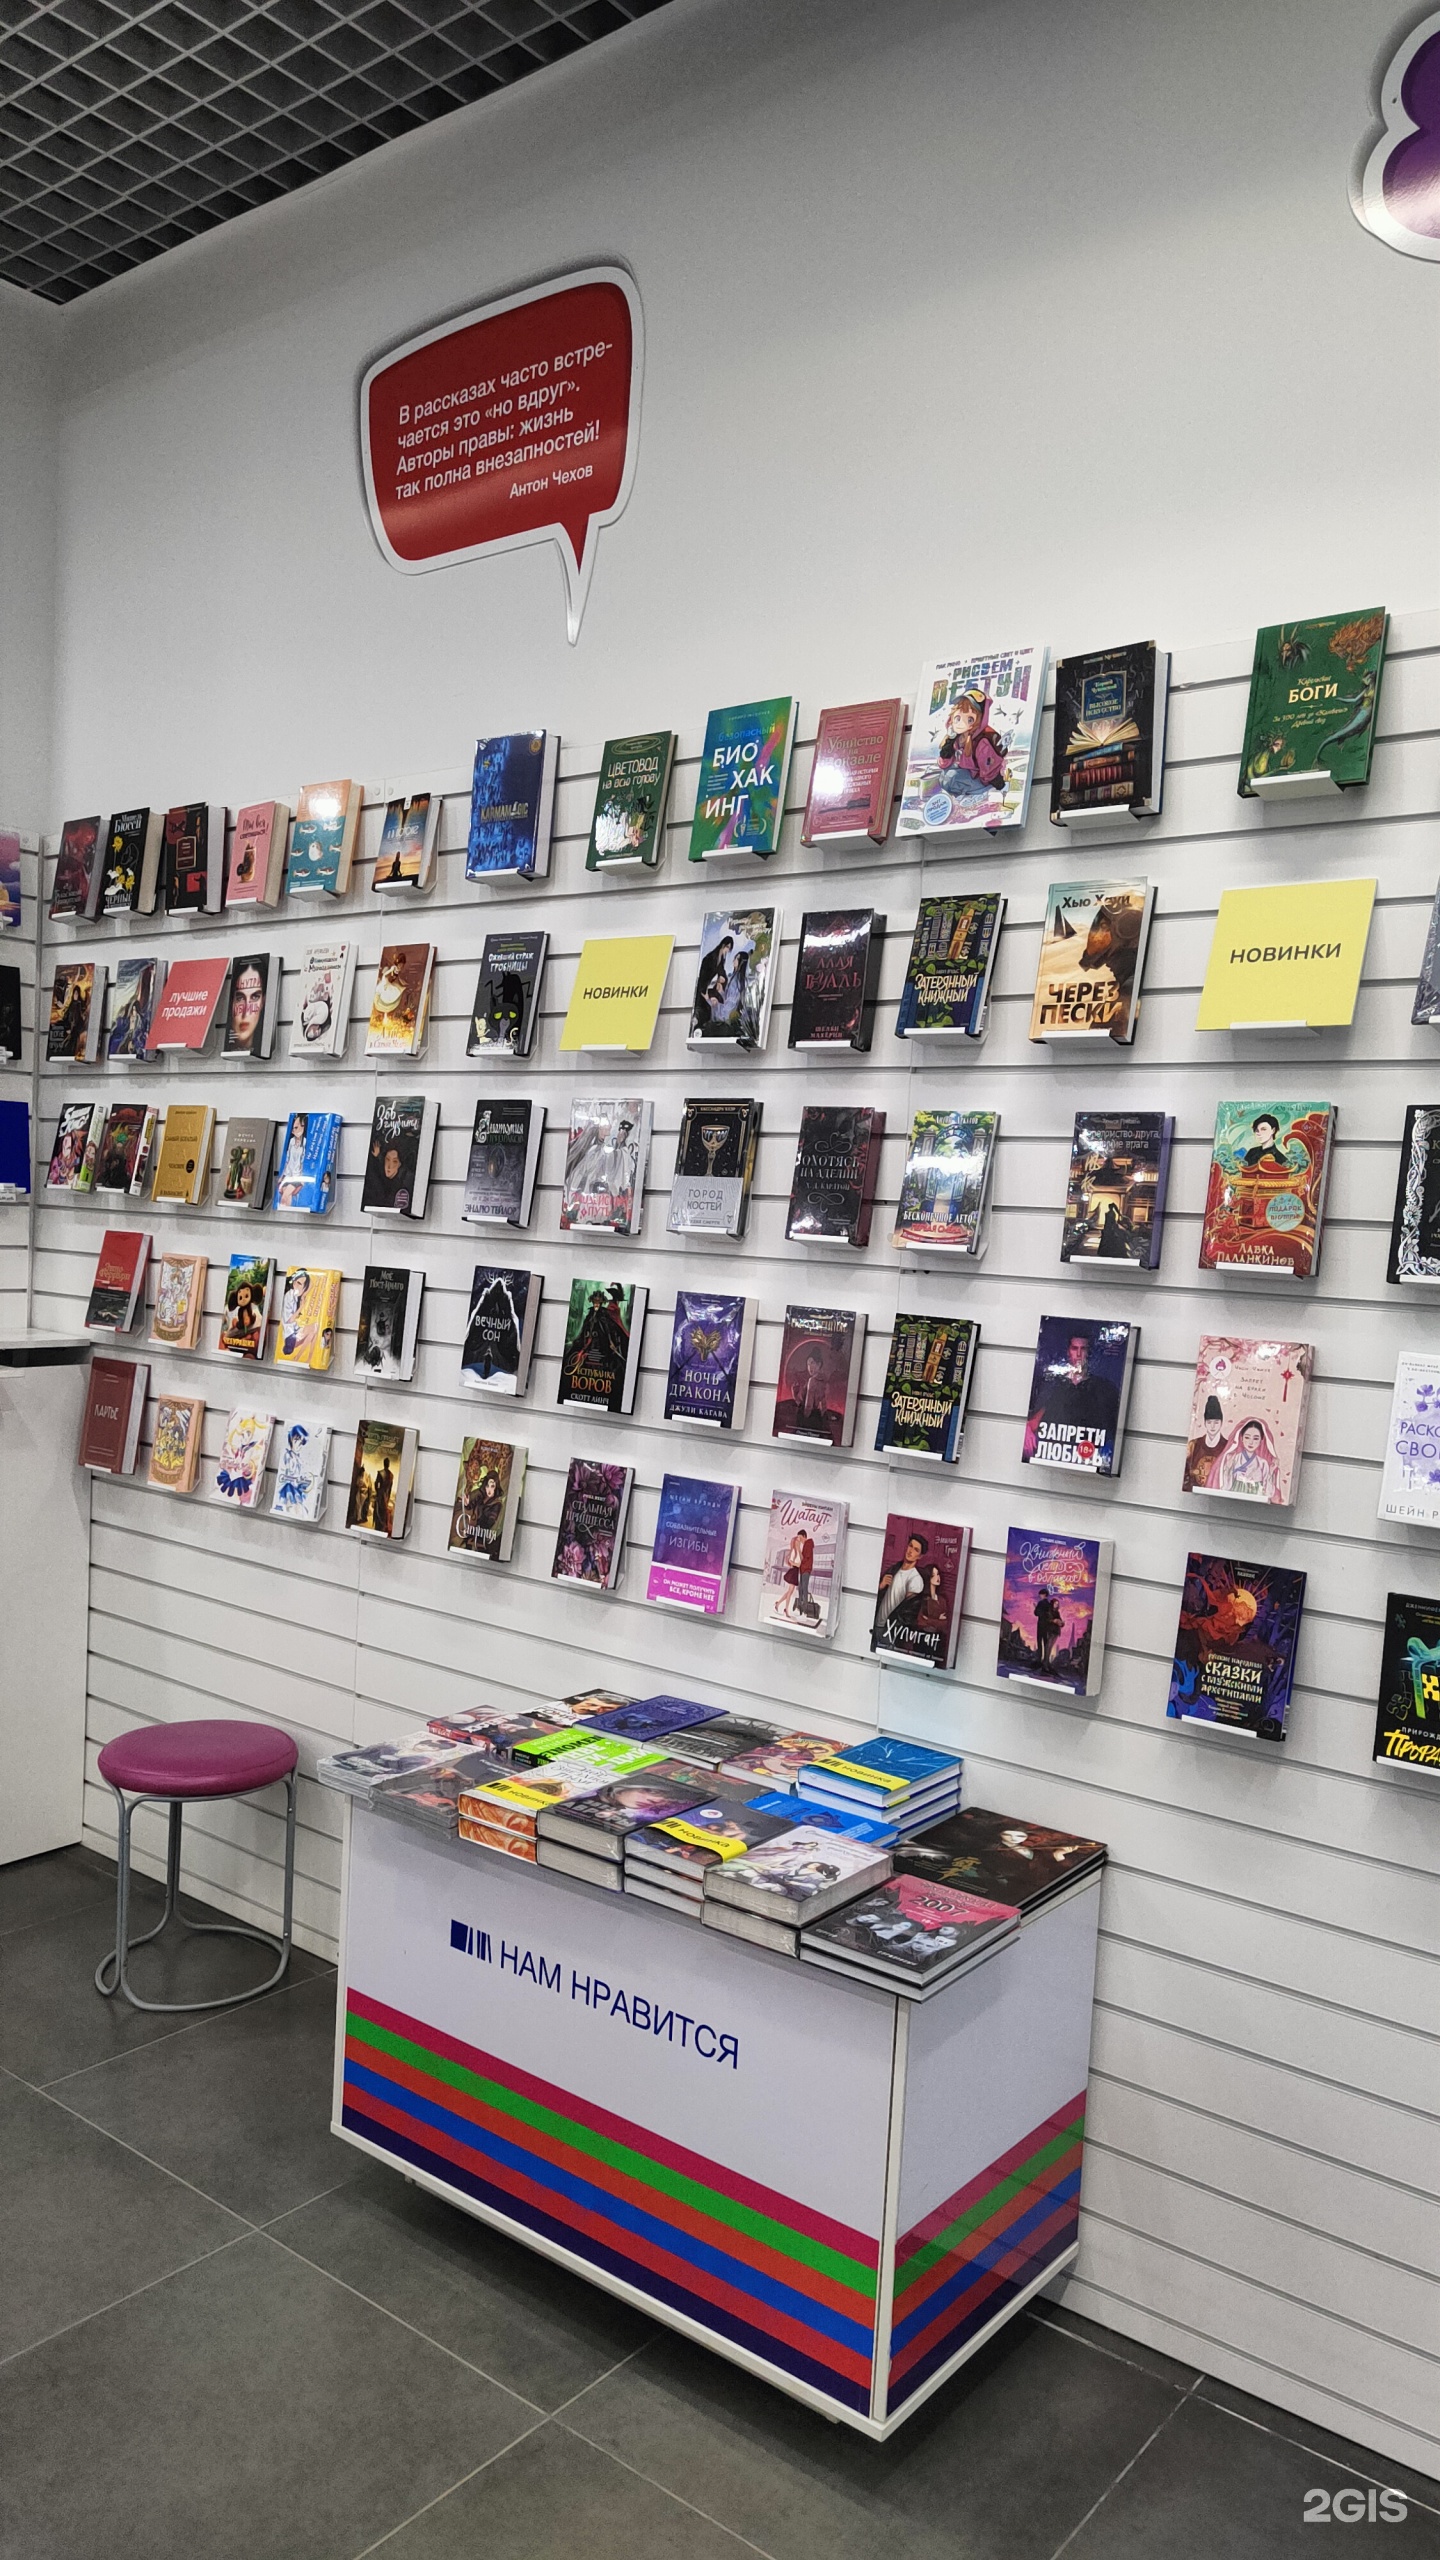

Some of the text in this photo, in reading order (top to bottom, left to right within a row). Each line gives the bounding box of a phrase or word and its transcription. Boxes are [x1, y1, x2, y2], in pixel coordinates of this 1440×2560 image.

[398, 339, 614, 426] В рассказах часто встре-
[397, 378, 581, 451] чается это «но вдруг».
[396, 408, 575, 476] Авторы правы: жизнь
[395, 420, 601, 501] так полна внезапностей!
[509, 463, 594, 500] Антон Чехов
[1288, 682, 1339, 704] БОГИ
[719, 722, 775, 743] безопасный
[827, 734, 884, 754] Убийство
[712, 741, 758, 768] БИО
[607, 758, 659, 779] ЦВЕТОВОД
[730, 764, 775, 790] ХАК
[602, 772, 662, 791] на всю голову
[705, 796, 750, 819] ИНГ
[1061, 896, 1091, 909] Хью
[1230, 943, 1342, 964] НОВИНКИ
[490, 961, 529, 974] ГРОБНИЦЫ
[169, 990, 209, 1006] лучшие
[582, 985, 650, 1000] НОВИНКИ
[917, 989, 970, 1007] КНИЖНЫЙ
[1048, 980, 1121, 1004] ЧЕРЕЗ
[161, 1004, 207, 1022] продажи
[1039, 1001, 1123, 1025] ПЕСКИ
[376, 1100, 398, 1131] Зов
[801, 1154, 860, 1169] ОХОТЯСЬ
[688, 1189, 724, 1201] ГОРОД
[687, 1200, 723, 1212] КОСТЕЙ
[903, 1210, 974, 1226] БЕСКОНЕЧНОЕ ЛЕТО
[1238, 1243, 1275, 1256] ЛАВКА
[1216, 1252, 1296, 1267] ПАЛАНКИНОВ
[474, 1315, 512, 1333] ВЕЧНЫЙ
[482, 1329, 502, 1344] СОН
[571, 1376, 613, 1395] ВОРОВ
[684, 1369, 720, 1387] НОЧЬ
[570, 1393, 592, 1403] СКОТТ
[669, 1382, 732, 1405] ДРАКОНА
[94, 1404, 119, 1421] КАРТЬЕ
[669, 1403, 728, 1419] ДЖУЛИ КАГАВА
[894, 1409, 945, 1429] КНИЖНЫЙ
[1038, 1421, 1107, 1448] ЗАПРЕТИ
[1079, 1444, 1093, 1455] 18+
[1395, 1440, 1440, 1459] СВО
[669, 1494, 691, 1504] МЕГАН
[571, 1500, 613, 1518] СТАЛЬНАЯ
[1385, 1503, 1425, 1520] ШЕЙН
[565, 1510, 615, 1533] ПРИНЦЕССА
[665, 1520, 717, 1539] СОБЛАЗНИТЕЛЬНЫЕ
[668, 1535, 709, 1554] ИЗГИБЫ
[883, 1618, 941, 1653] Хулиган
[678, 1827, 731, 1849] новинка
[909, 1895, 971, 1918] 2007
[500, 1940, 740, 2070] НАМ НРАВИТСЯ
